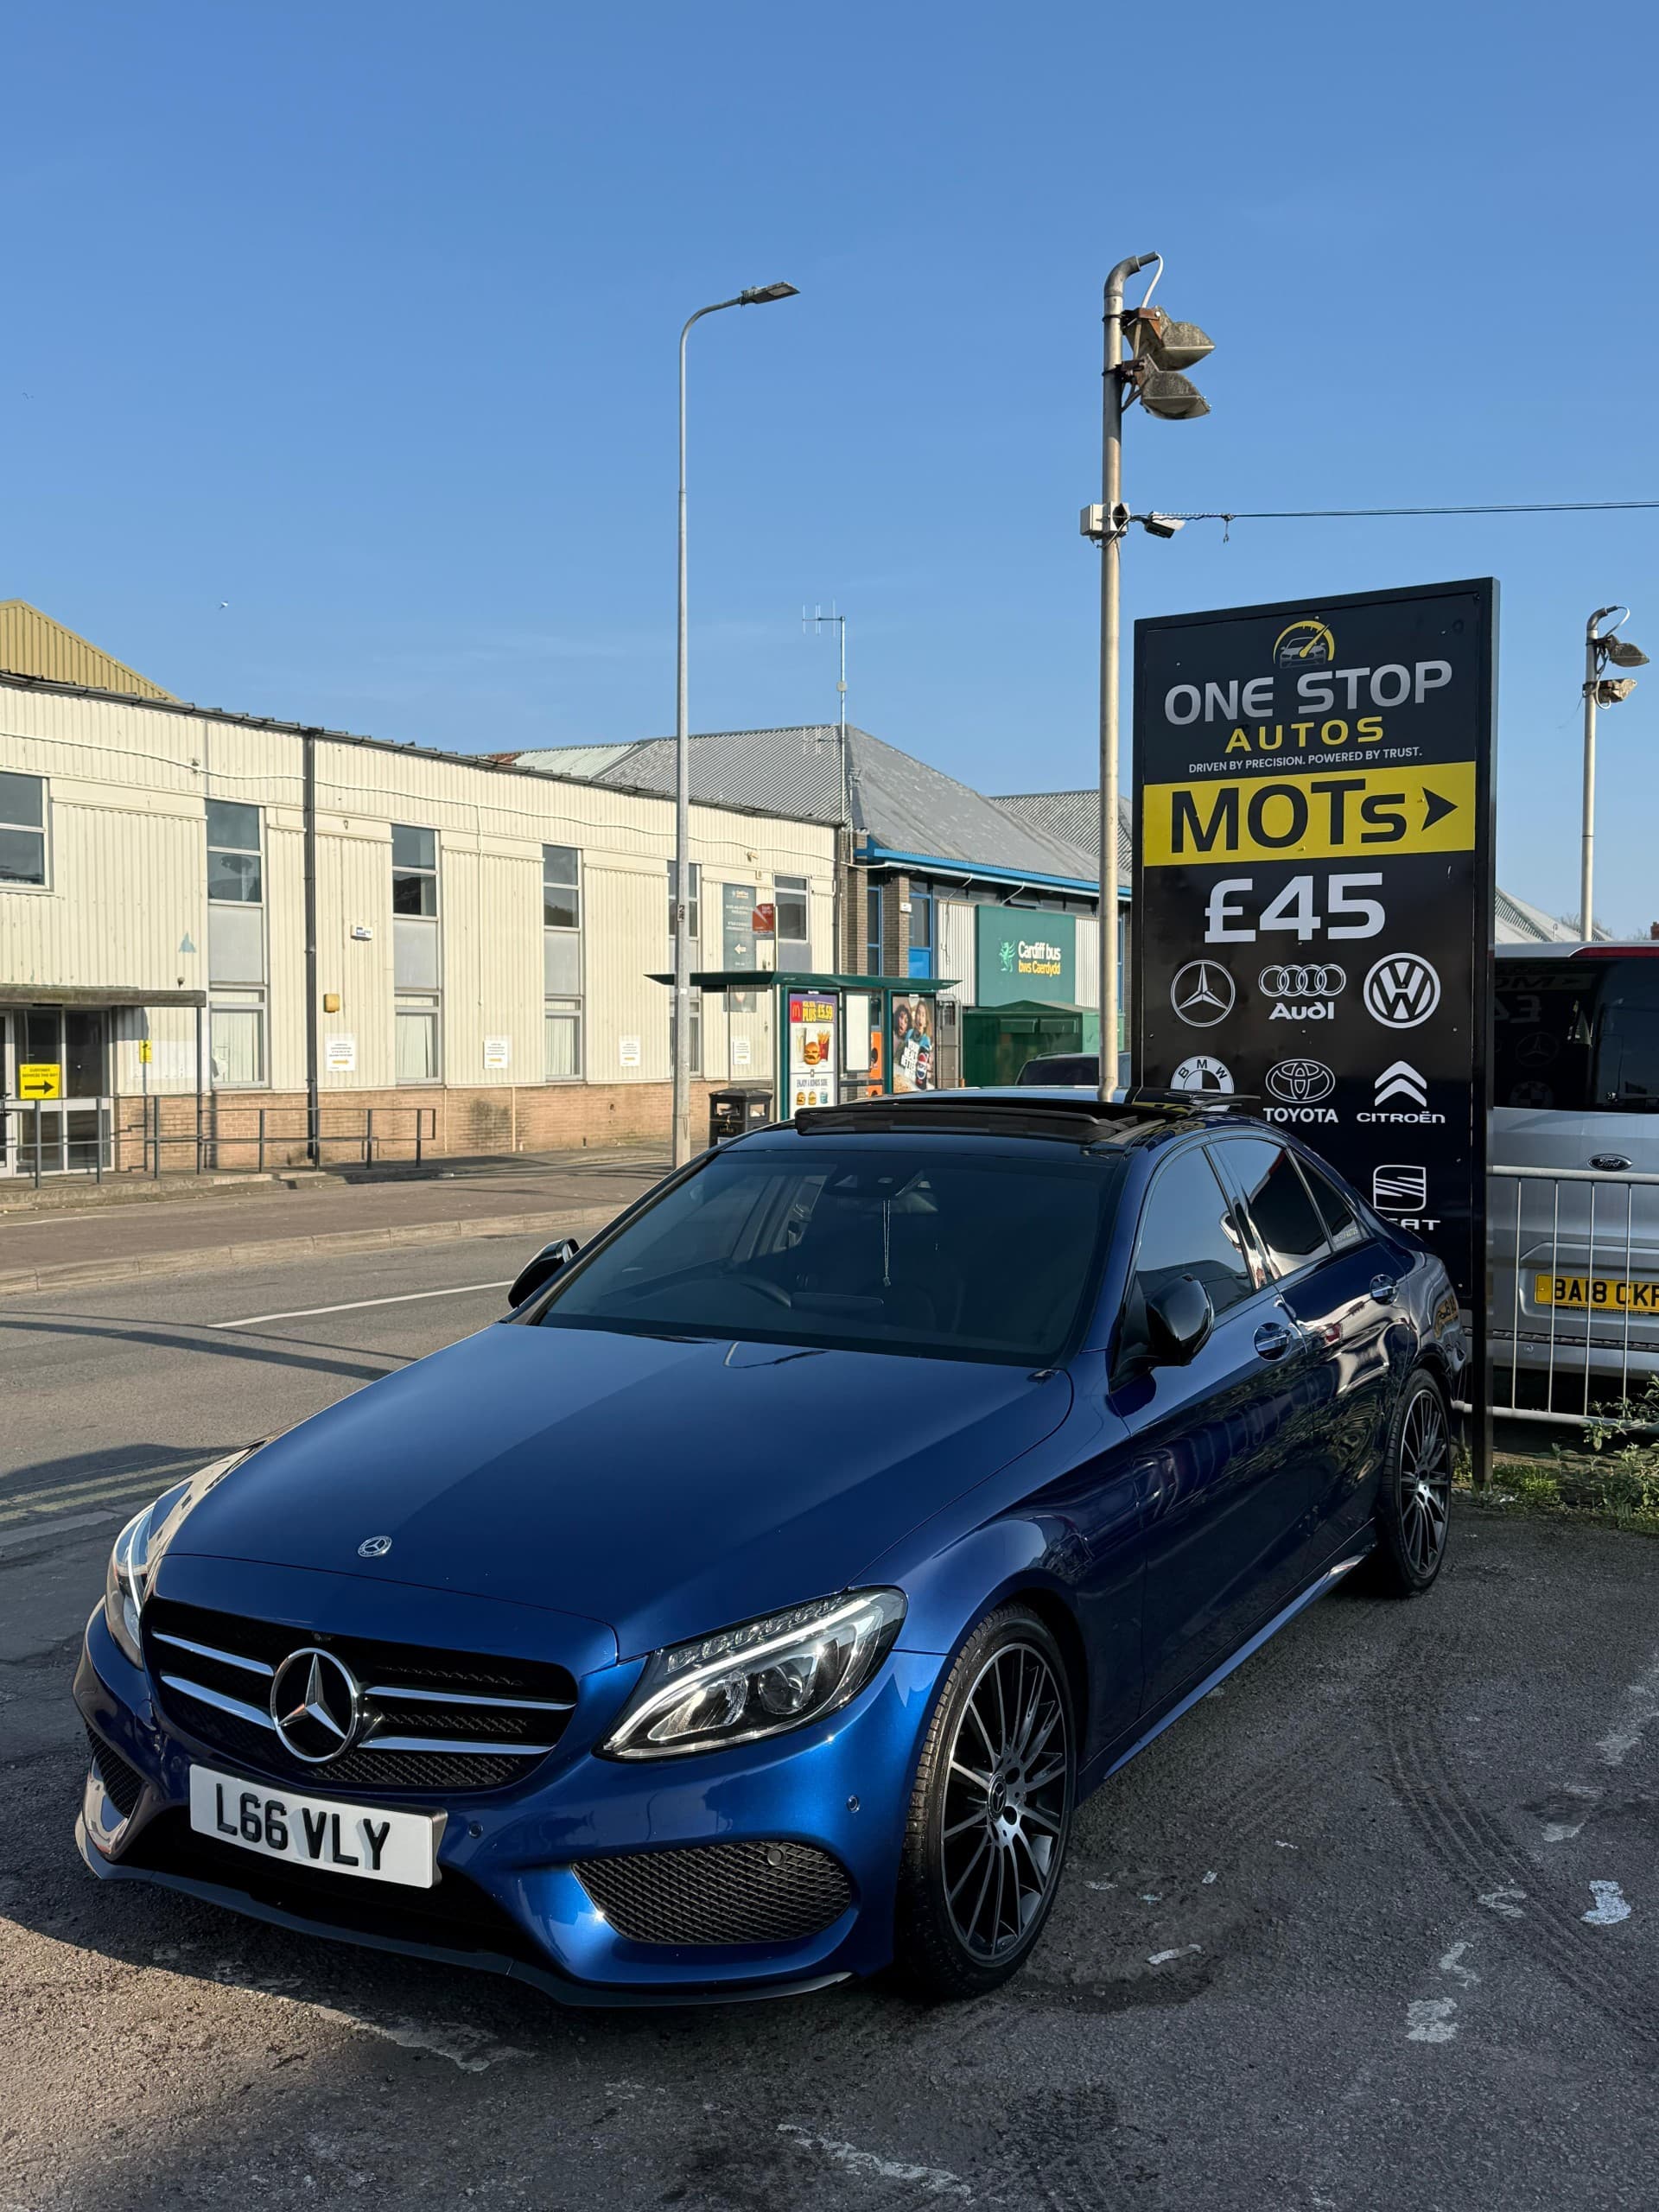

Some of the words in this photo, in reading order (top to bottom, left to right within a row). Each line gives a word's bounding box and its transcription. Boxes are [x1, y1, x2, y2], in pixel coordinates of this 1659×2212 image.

[1164, 677, 1274, 726] ONE
[1297, 659, 1452, 714] STOP
[1224, 716, 1384, 753] AUTOS
[1189, 762, 1227, 773] DRIVEN
[1230, 760, 1243, 770] BY
[1246, 756, 1306, 769] PRECISION.
[1308, 751, 1363, 764] POWERED
[1365, 749, 1380, 760] BY
[1383, 747, 1422, 759] TRUST.
[1171, 779, 1408, 854] MOTs
[1205, 872, 1386, 943] £45
[1018, 940, 1045, 959] Cardiff
[1046, 944, 1061, 960] bus
[1018, 960, 1032, 973] bws
[1032, 961, 1061, 977] Caerdydd
[802, 1008, 816, 1022] PLUS
[1268, 1002, 1335, 1020] Audi
[1178, 1058, 1229, 1080] BMW
[1263, 1108, 1339, 1123] TOYOTA
[1598, 1158, 1621, 1168] Ford
[1389, 1218, 1441, 1230] AT
[1554, 1278, 1607, 1303] BA18
[215, 1783, 288, 1851] L66
[302, 1807, 391, 1871] VLY
